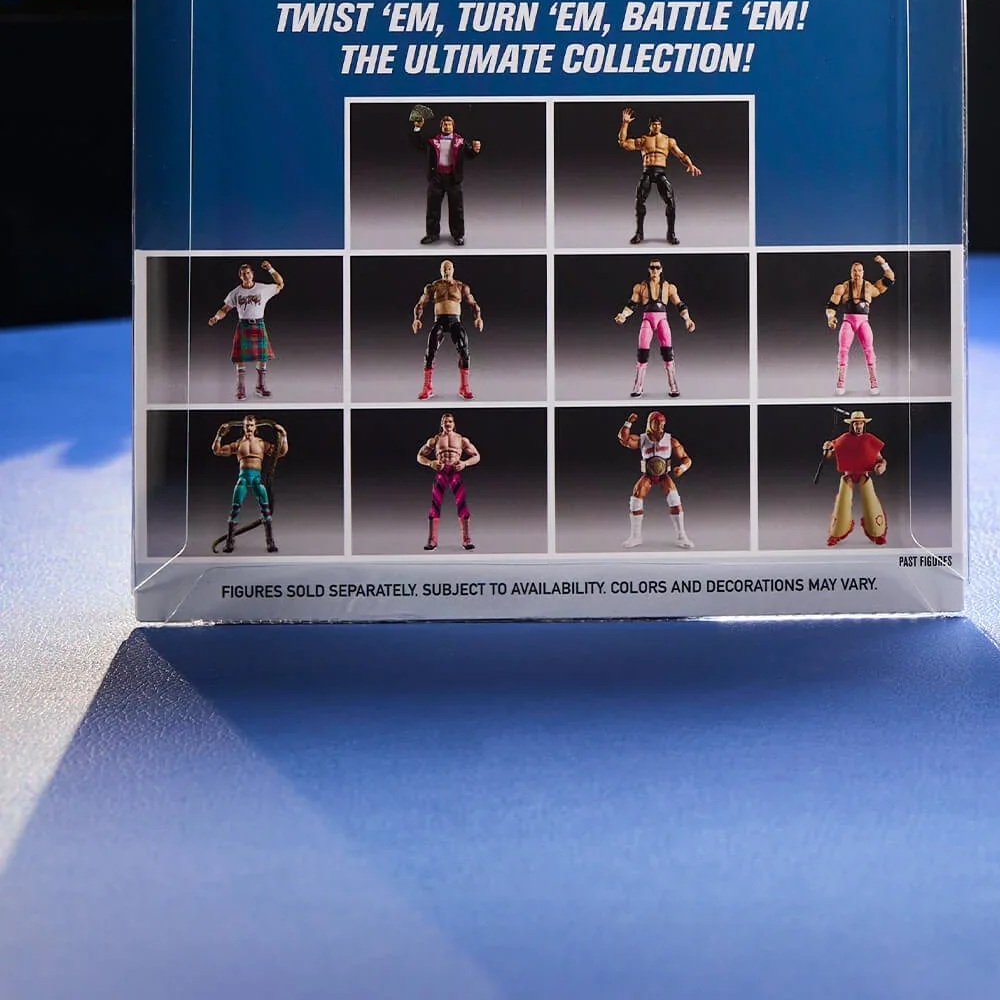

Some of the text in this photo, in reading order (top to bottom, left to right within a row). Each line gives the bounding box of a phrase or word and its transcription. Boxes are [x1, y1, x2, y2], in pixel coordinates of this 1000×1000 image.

[276, 2, 374, 32] TWIST
[457, 1, 539, 32] TURN
[621, 1, 733, 31] BATTLE
[341, 42, 755, 74] THE ULTIMATE COLLECTION!
[899, 556, 952, 567] PAST FIGURES
[221, 577, 877, 598] FIGURES SOLD SEPARATELY. SUBJECT TO AVAILABILITY. COLORS AND DECORATIONS MAY VARY.
